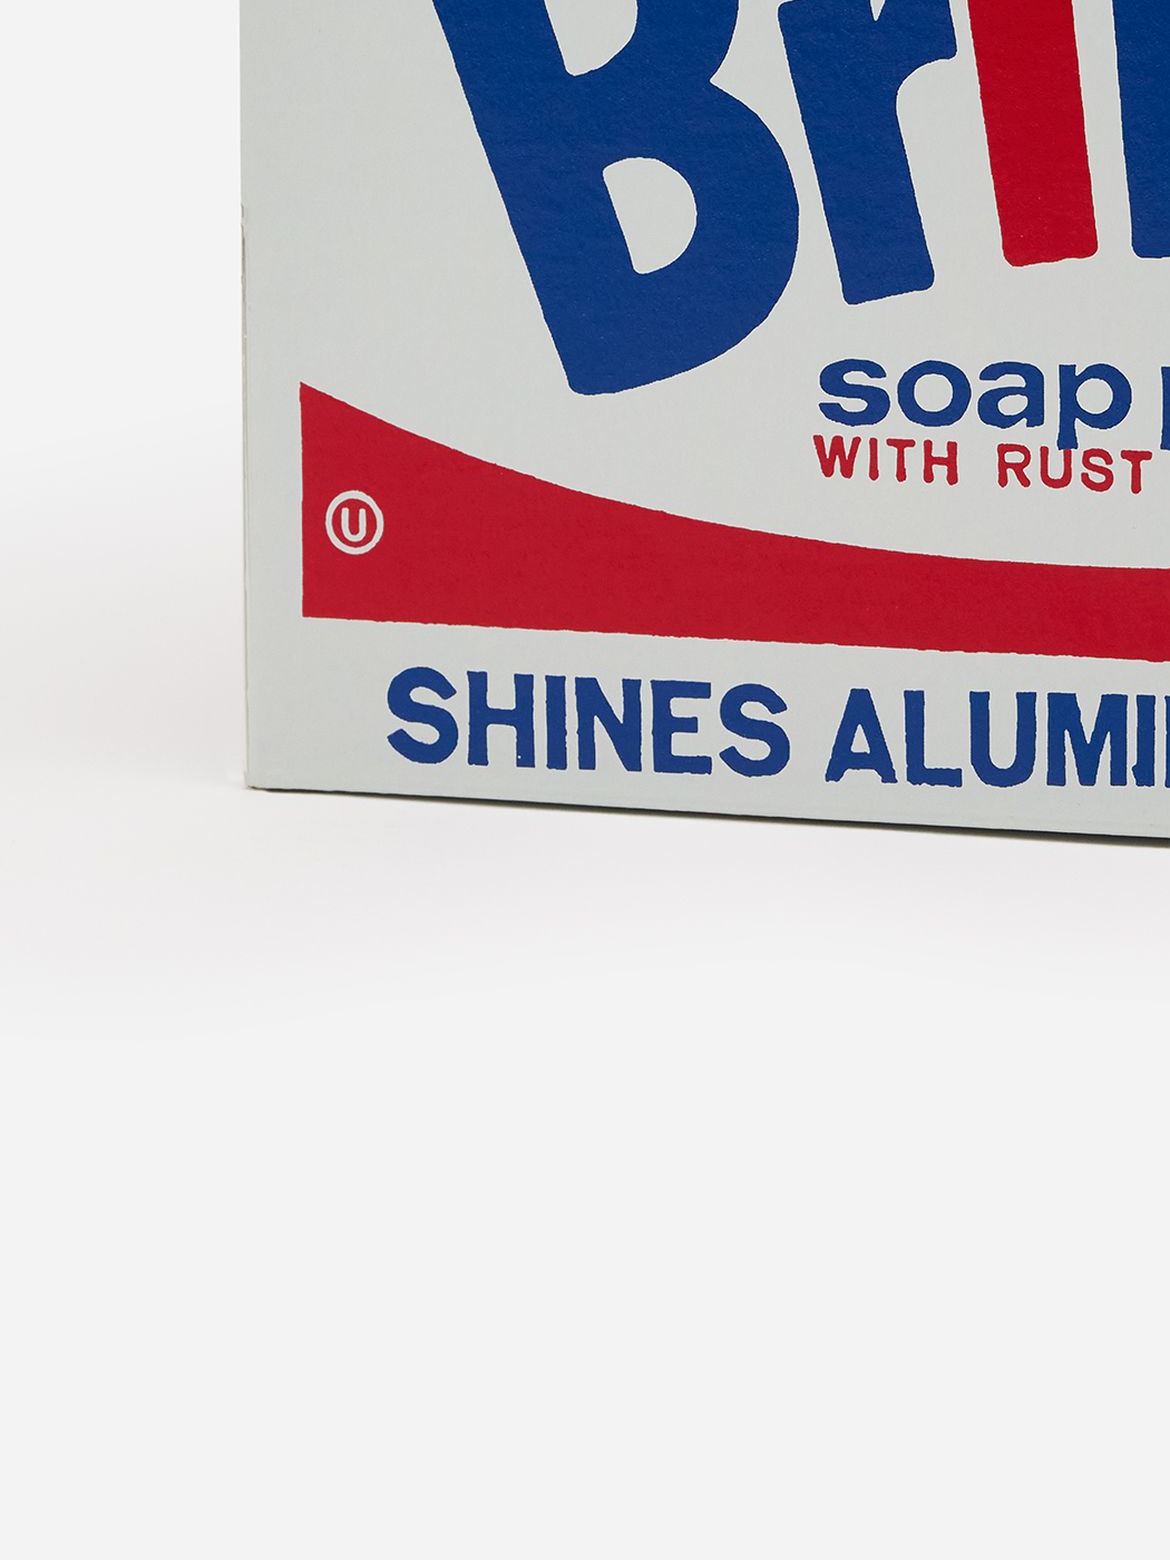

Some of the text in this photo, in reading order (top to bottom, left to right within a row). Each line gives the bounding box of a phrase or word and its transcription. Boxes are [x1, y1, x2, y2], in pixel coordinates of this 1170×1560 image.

[818, 358, 1133, 451] soap
[811, 434, 960, 487] WITH
[996, 443, 1153, 495] RUST
[386, 665, 791, 777] SHINES
